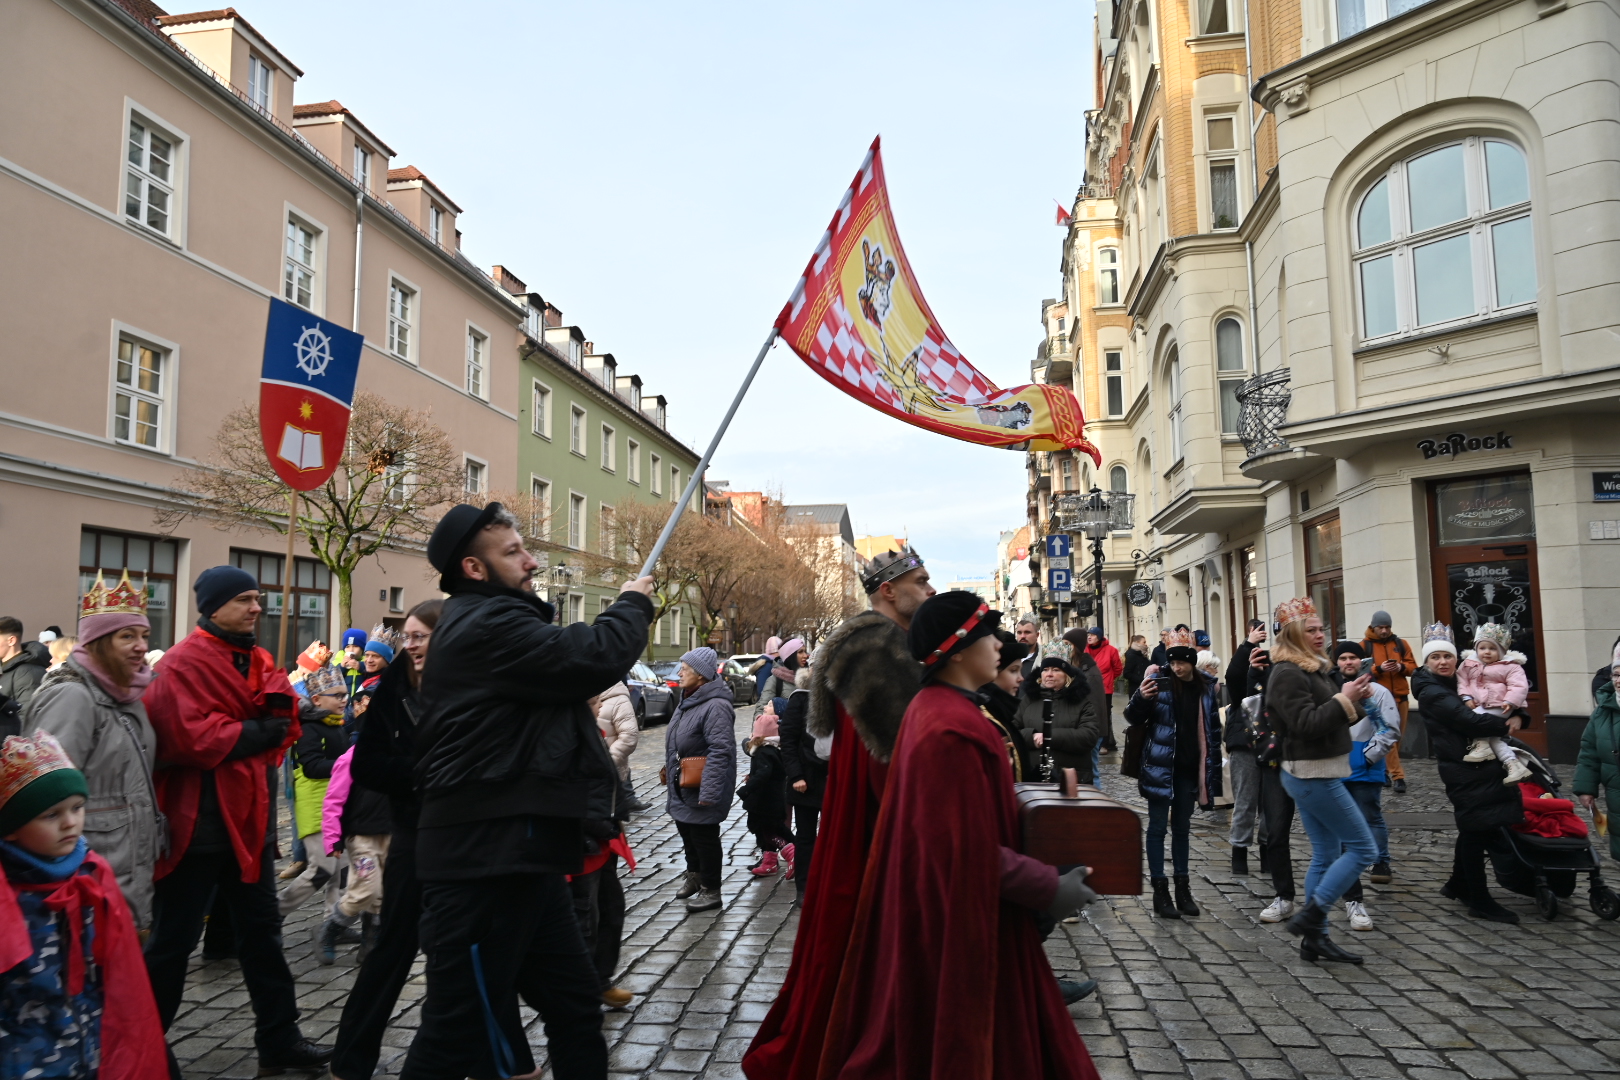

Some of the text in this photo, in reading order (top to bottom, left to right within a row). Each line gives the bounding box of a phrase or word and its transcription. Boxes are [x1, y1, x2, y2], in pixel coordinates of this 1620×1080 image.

[1416, 431, 1513, 461] BaRock
[1053, 571, 1066, 589] P
[1464, 565, 1510, 577] BaRock
